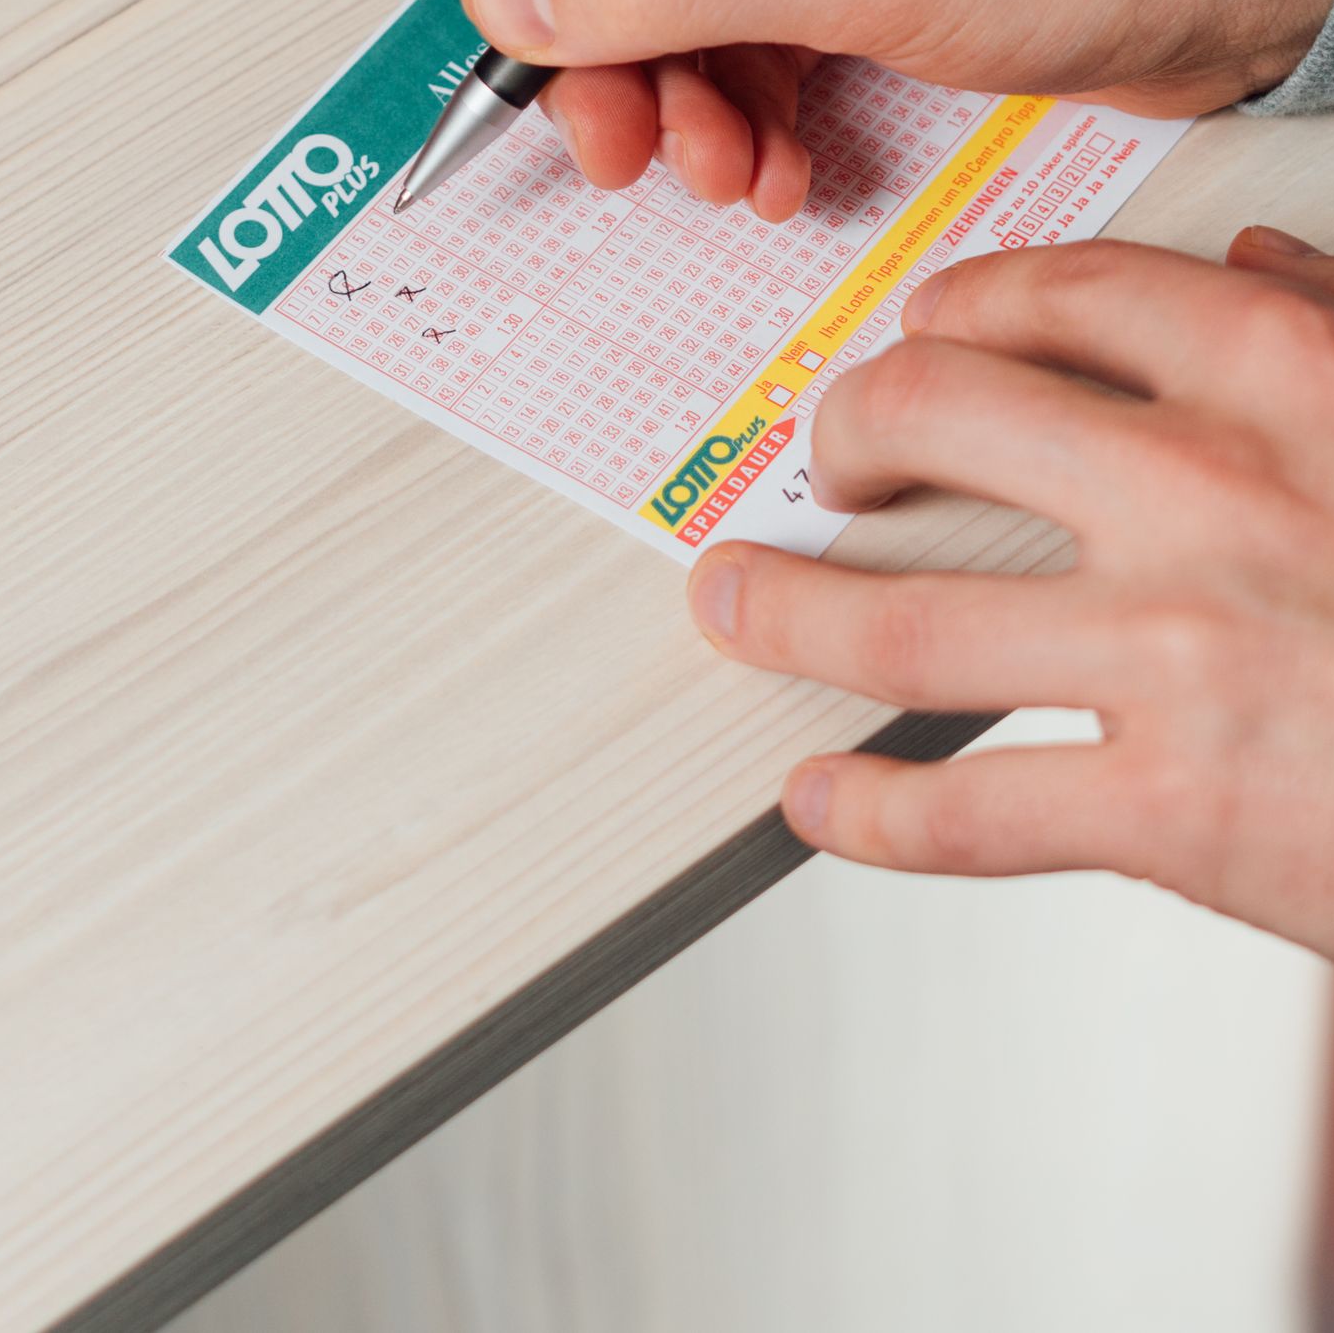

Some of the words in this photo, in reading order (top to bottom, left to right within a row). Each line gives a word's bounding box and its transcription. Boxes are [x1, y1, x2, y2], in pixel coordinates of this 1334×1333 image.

[947, 107, 973, 129] 1,30
[197, 133, 355, 294] LOTTO
[321, 155, 380, 219] PLUS
[858, 206, 885, 229] 1,30
[942, 166, 1018, 246] ZIEHUNGEN
[993, 209, 1013, 227] bis
[1011, 196, 1025, 210] zu
[1021, 179, 1039, 196] 10
[1036, 151, 1064, 180] Joker
[1062, 115, 1097, 151] spielen
[1038, 205, 1050, 215] 4
[1052, 189, 1064, 199] 3
[1066, 172, 1079, 183] 2
[1042, 230, 1061, 245] Ja
[1057, 213, 1075, 228] Ja
[1071, 197, 1090, 212] Ja
[1086, 180, 1104, 195] Ja
[1100, 163, 1118, 179] Ja
[1112, 137, 1141, 165] Nein
[289, 302, 298, 312] 1
[305, 284, 316, 296] 2
[321, 267, 332, 279] 3
[338, 251, 349, 262] 4
[354, 234, 365, 246] 5
[370, 218, 381, 229] 6
[591, 212, 618, 234] 1,30
[819, 312, 849, 339] Ihre
[841, 280, 875, 314] Lotto
[866, 253, 904, 285] Tipps
[899, 207, 943, 253] nehmen
[940, 188, 961, 207] um
[952, 172, 973, 188] 50
[965, 146, 997, 174] Cent
[994, 127, 1013, 149] pro
[1007, 99, 1036, 127] Tipp
[310, 313, 321, 325] 7
[326, 296, 337, 308] 8
[356, 261, 373, 276] 10
[372, 245, 389, 259] 11
[388, 228, 405, 243] 12
[328, 324, 345, 339] 13
[345, 307, 362, 322] 14
[767, 306, 795, 329] 1,30
[463, 402, 472, 412] 1
[479, 383, 490, 395] 2
[495, 366, 506, 378] 3
[512, 349, 523, 360] 4
[528, 331, 539, 343] 5
[544, 314, 555, 326] 6
[497, 313, 524, 335] 1,30
[755, 380, 772, 396] Ja
[779, 339, 808, 365] Nein
[797, 403, 809, 414] 1
[813, 383, 827, 395] 2
[844, 348, 856, 360] 4
[858, 332, 871, 344] 5
[874, 315, 887, 327] 6
[888, 299, 901, 309] 7
[919, 265, 932, 276] 9
[931, 246, 948, 260] 10
[484, 413, 495, 425] 7
[501, 395, 512, 407] 8
[517, 378, 528, 389] 9
[531, 359, 548, 373] 10
[547, 342, 564, 356] 11
[563, 324, 580, 339] 12
[504, 424, 521, 438] 13
[520, 406, 537, 421] 14
[536, 388, 553, 403] 15
[553, 371, 570, 385] 16
[569, 353, 586, 368] 17
[585, 336, 602, 351] 18
[526, 436, 543, 451] 19
[542, 418, 559, 433] 20
[559, 400, 576, 415] 21
[575, 383, 592, 397] 22
[591, 365, 608, 380] 23
[607, 348, 624, 362] 24
[548, 448, 565, 463] 25
[565, 430, 582, 445] 26
[581, 413, 598, 427] 27
[597, 395, 614, 409] 28
[613, 377, 630, 392] 29
[629, 360, 646, 374] 30
[674, 409, 702, 433] 1,30
[571, 461, 588, 475] 31
[587, 443, 604, 457] 32
[603, 425, 620, 439] 33
[619, 407, 636, 421] 34
[635, 389, 652, 404] 35
[651, 372, 668, 386] 36
[593, 473, 610, 488] 37
[610, 455, 627, 469] 38
[626, 437, 643, 451] 39
[642, 419, 659, 434] 40
[658, 401, 675, 416] 41
[674, 384, 691, 398] 42
[734, 416, 766, 452] PLUS
[616, 486, 633, 500] 43
[632, 467, 649, 482] 44
[648, 449, 665, 464] 45
[651, 434, 738, 527] LOTTO
[683, 429, 788, 541] SPIELDAUER
